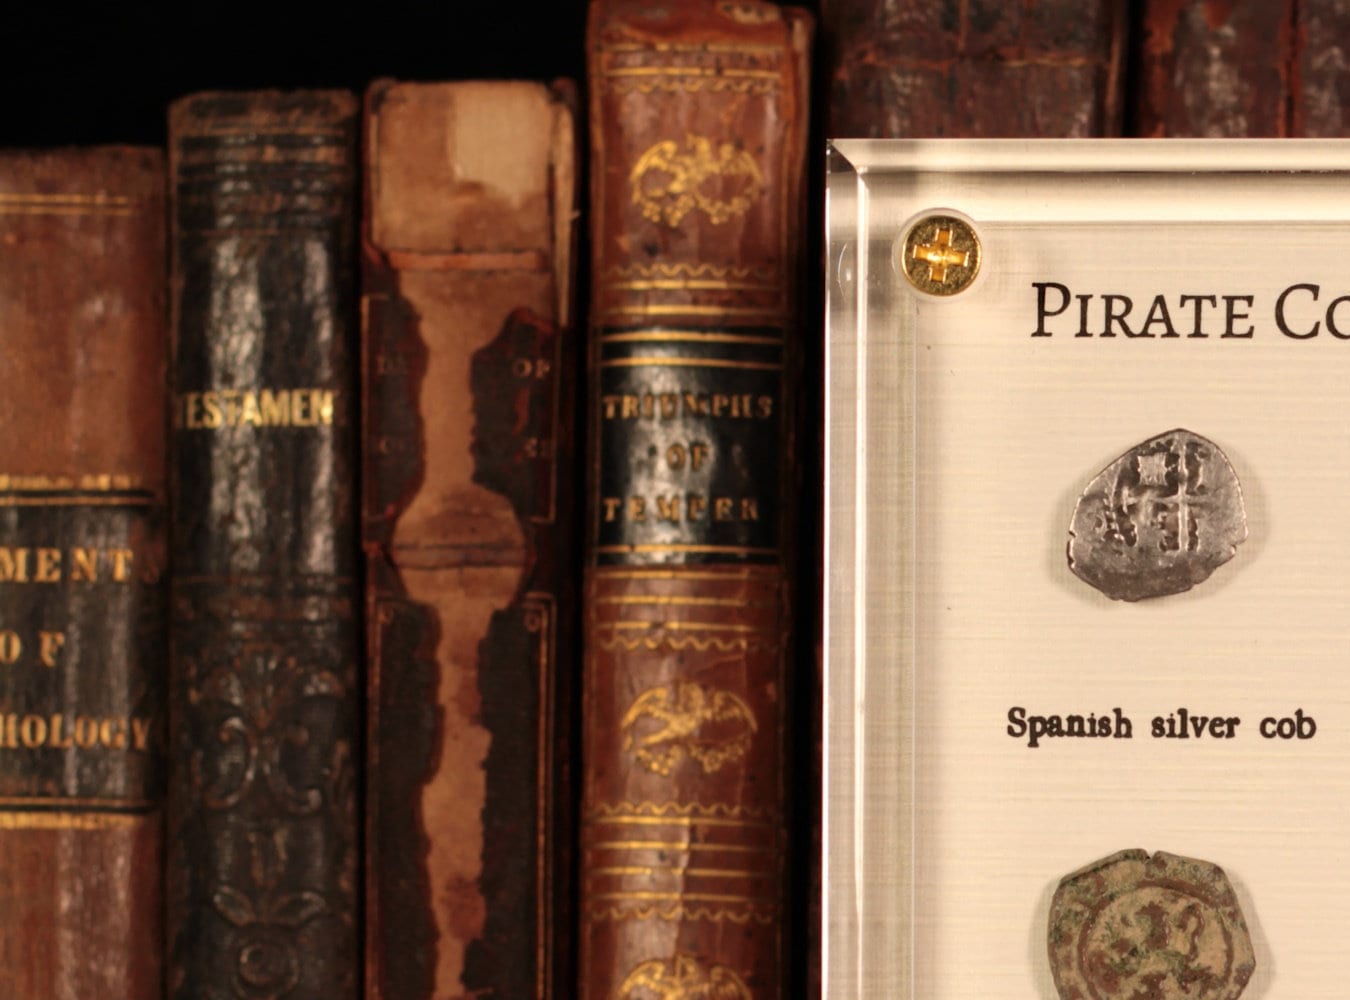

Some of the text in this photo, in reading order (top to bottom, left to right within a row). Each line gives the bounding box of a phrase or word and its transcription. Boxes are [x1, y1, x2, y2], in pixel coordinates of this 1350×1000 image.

[1030, 281, 1255, 339] PIRATE
[174, 387, 347, 429] ESTAMEN
[666, 443, 709, 470] OF
[0, 630, 65, 666] OF
[1007, 706, 1318, 748] Spanish silver cob
